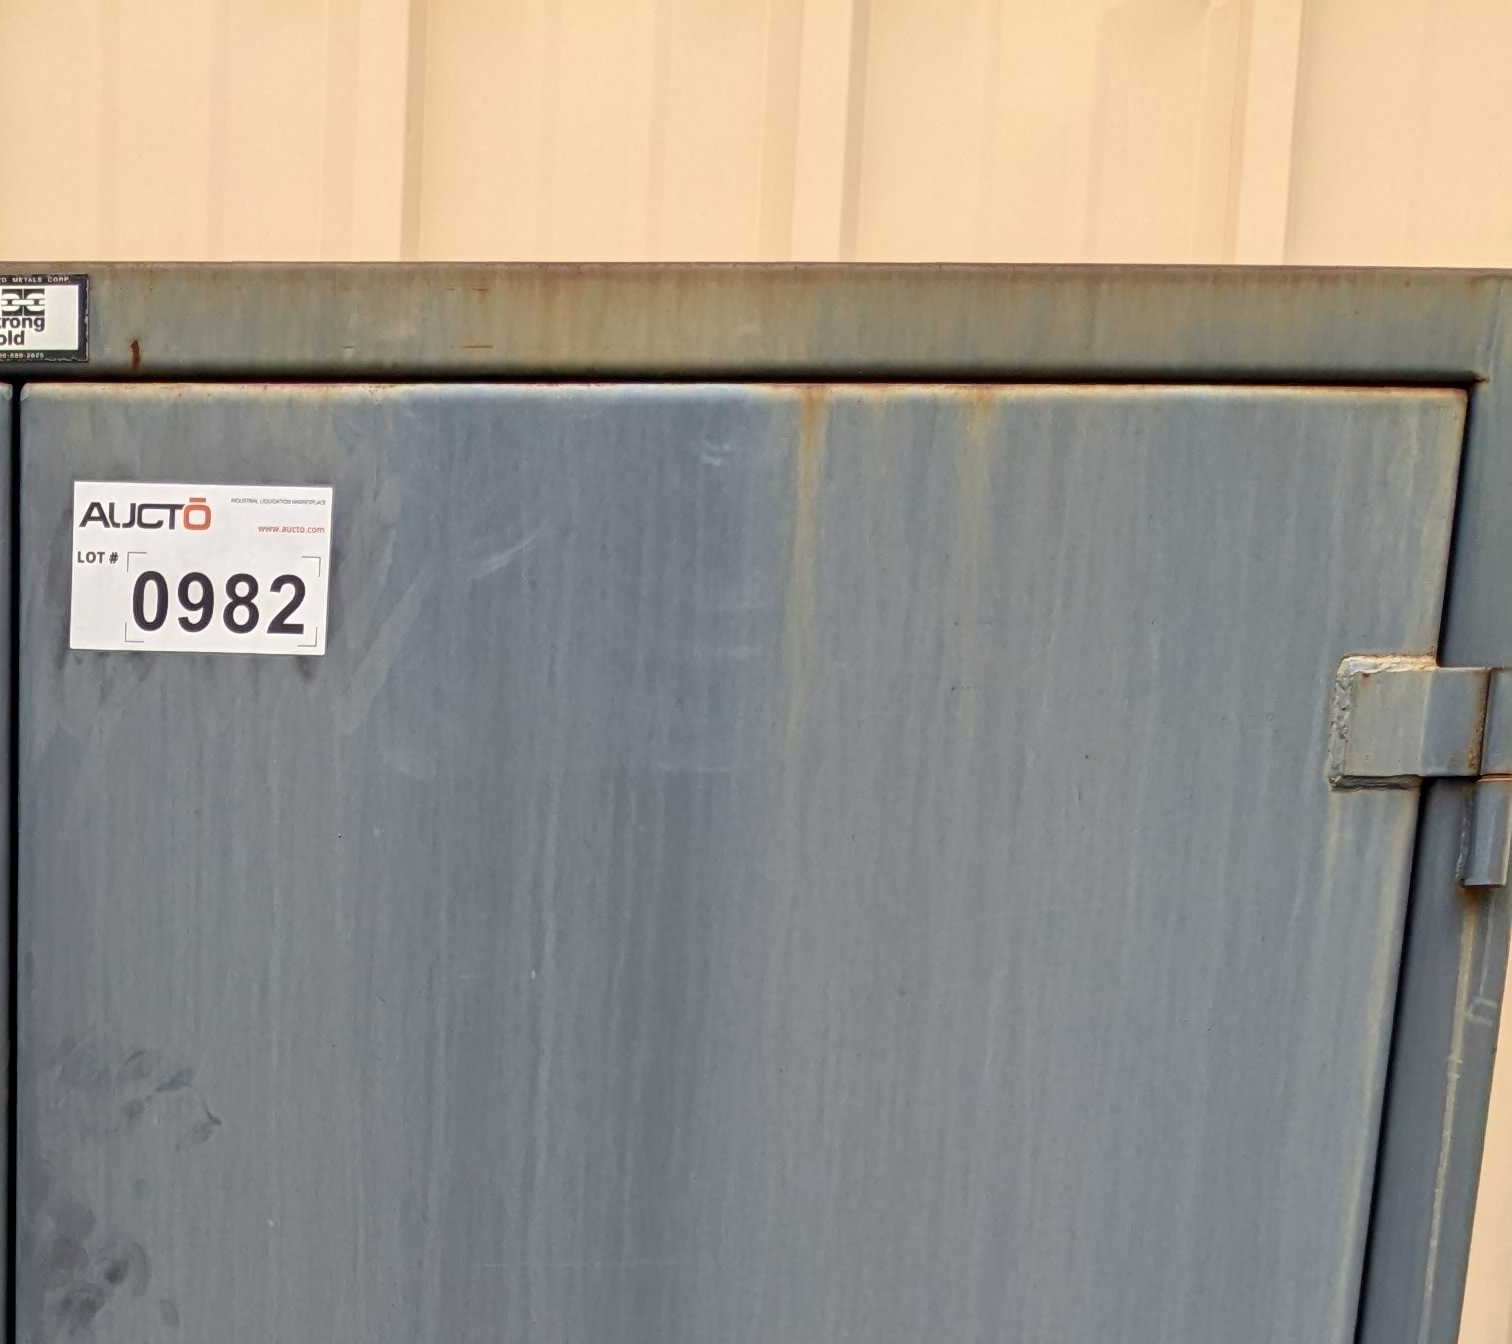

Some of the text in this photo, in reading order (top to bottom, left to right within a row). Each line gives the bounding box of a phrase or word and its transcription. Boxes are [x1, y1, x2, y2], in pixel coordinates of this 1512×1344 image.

[258, 525, 326, 534] www.aucto.com
[77, 551, 119, 564] LOT #
[132, 570, 306, 635] 0982
